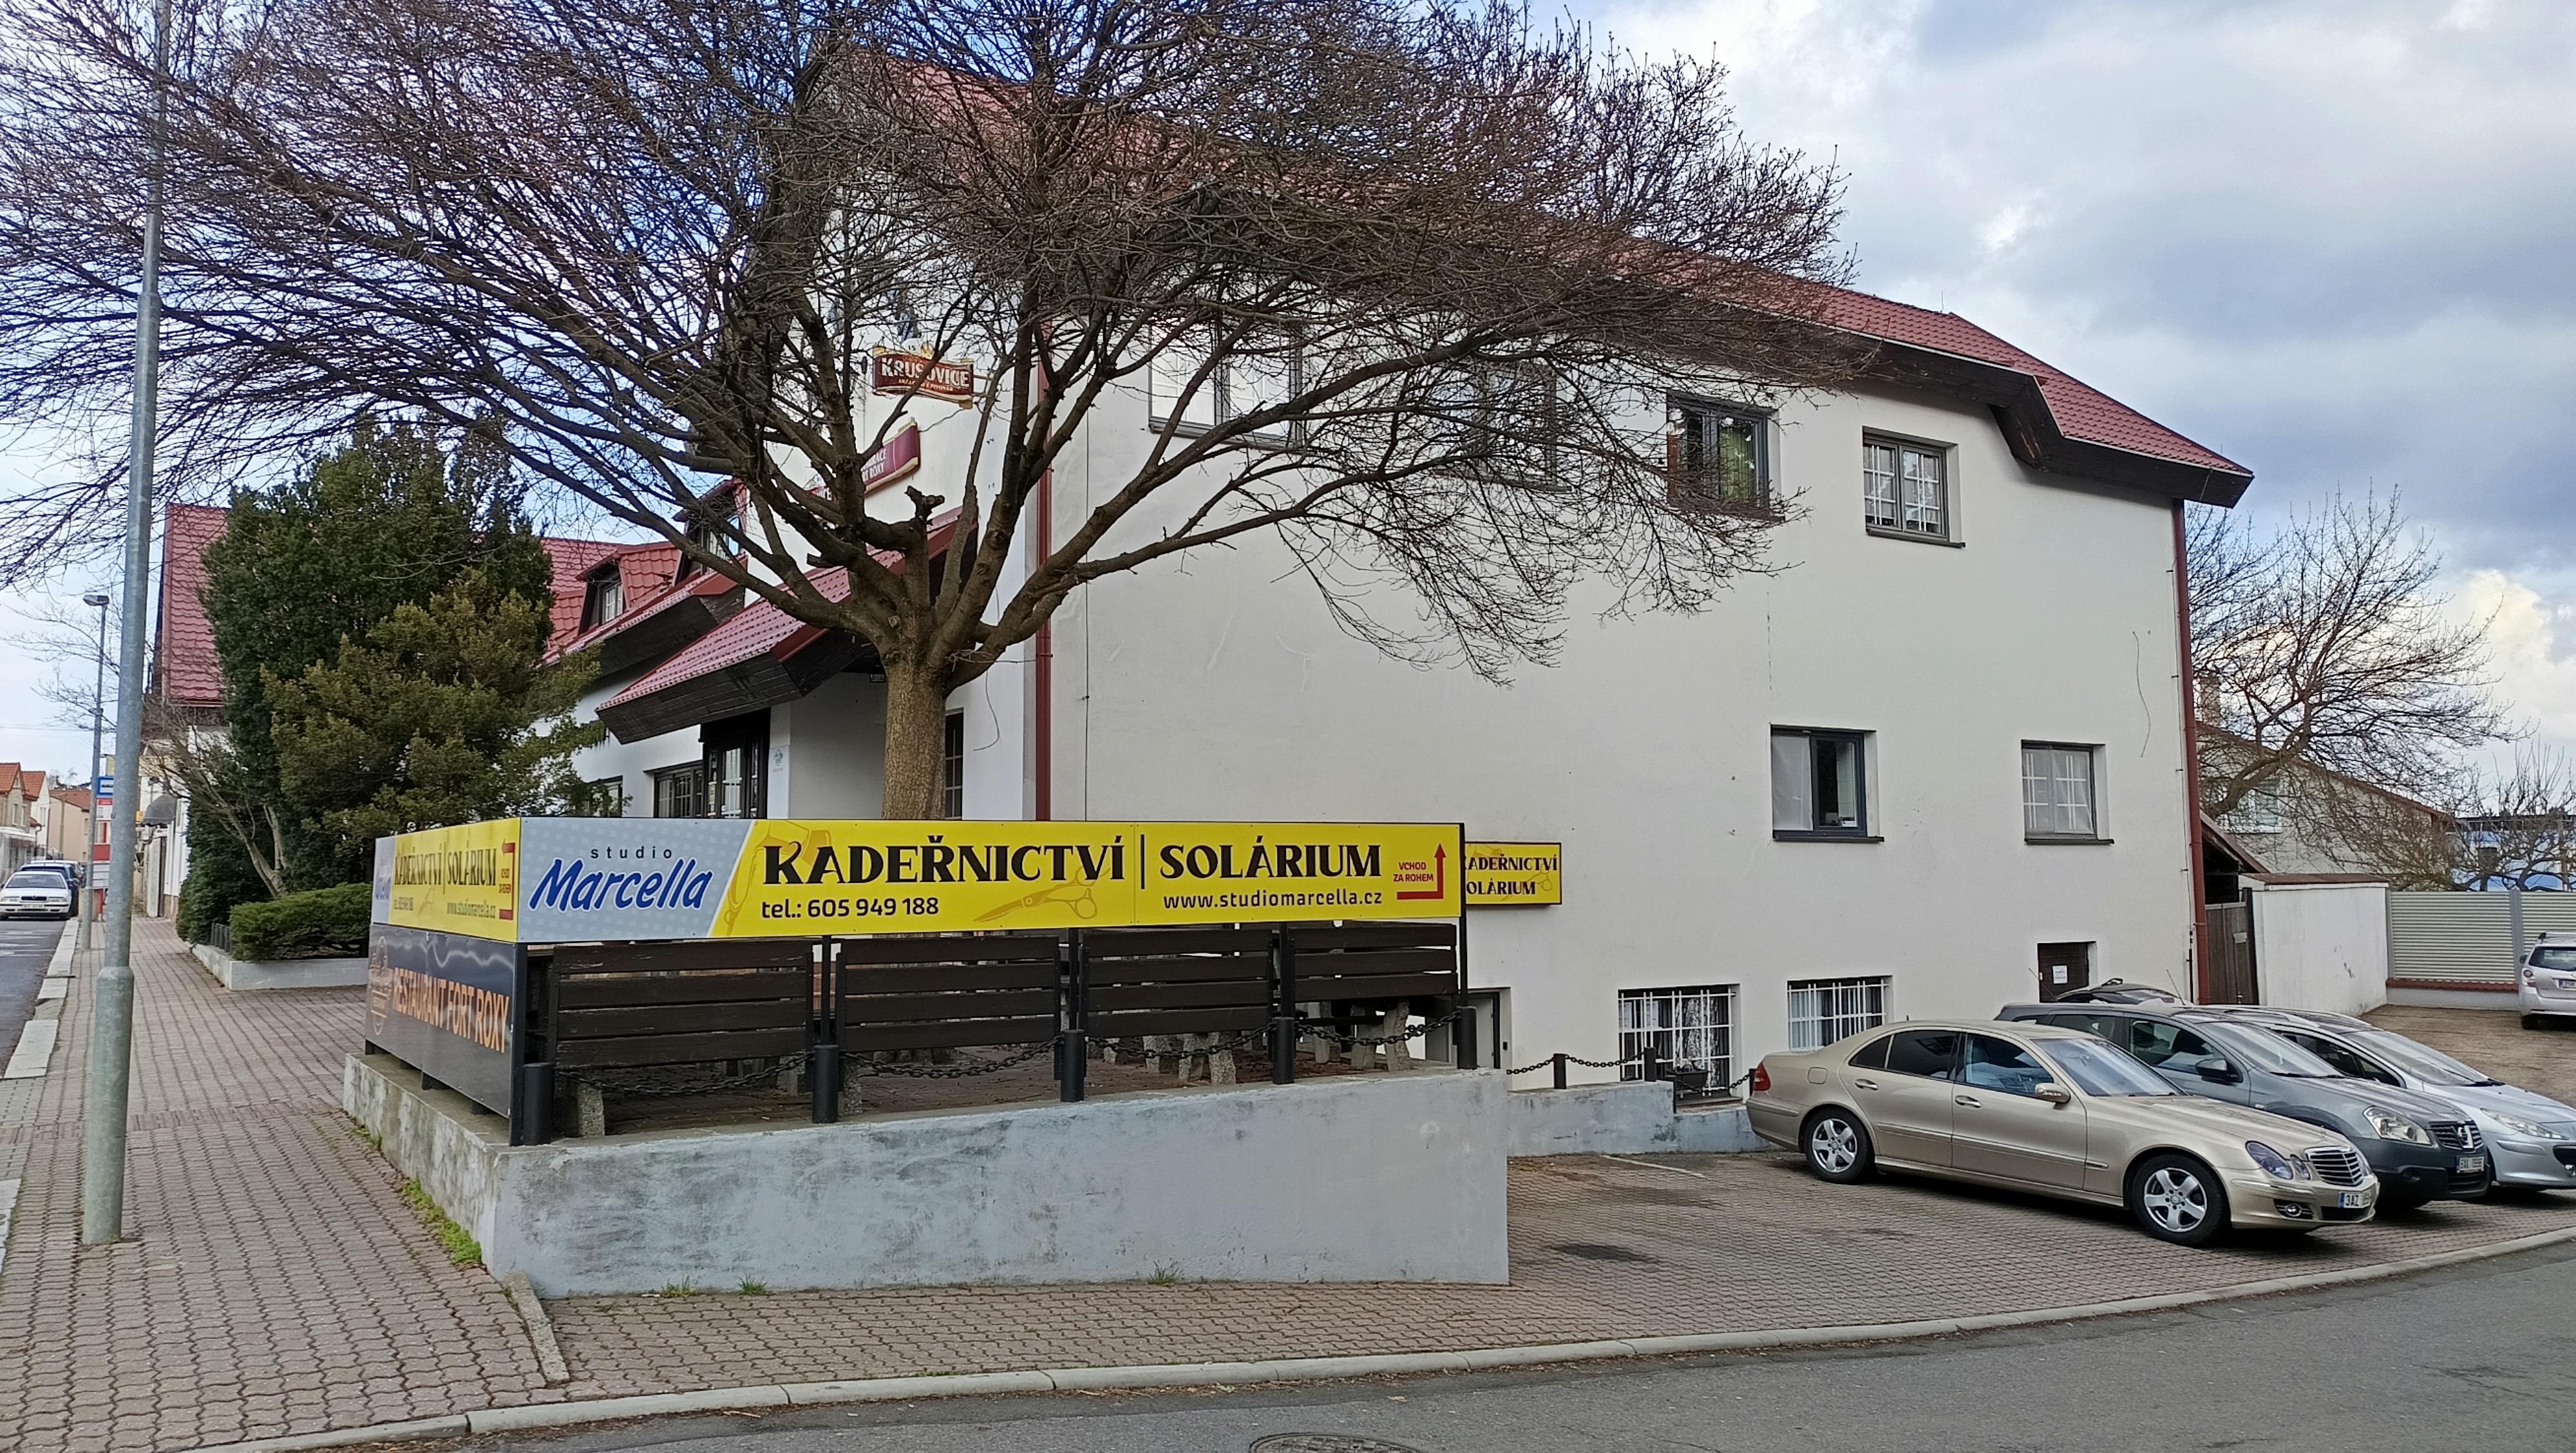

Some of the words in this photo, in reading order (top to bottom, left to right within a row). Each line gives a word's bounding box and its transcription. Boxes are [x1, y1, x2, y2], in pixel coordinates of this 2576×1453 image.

[591, 846, 672, 859] studio
[763, 835, 1125, 885] KADEŘNICTVÍ
[1160, 835, 1382, 879] SOLÁRIUM
[448, 840, 497, 886] SOLÁRIUM
[1398, 862, 1426, 870] VCHOD
[529, 859, 713, 912] Marcella
[1393, 873, 1403, 882] ZA
[1405, 873, 1434, 882] ROHEM
[1466, 878, 1536, 895] OLÁRIUM
[762, 898, 801, 918] tel.:
[808, 899, 849, 917] 605
[856, 898, 896, 916] 949
[902, 897, 939, 915] 188
[1164, 889, 1382, 909] www.studiomarcella.cz
[393, 967, 447, 1028] RESTAURANT
[447, 981, 475, 1040] FORT
[475, 989, 509, 1054] ROXY
